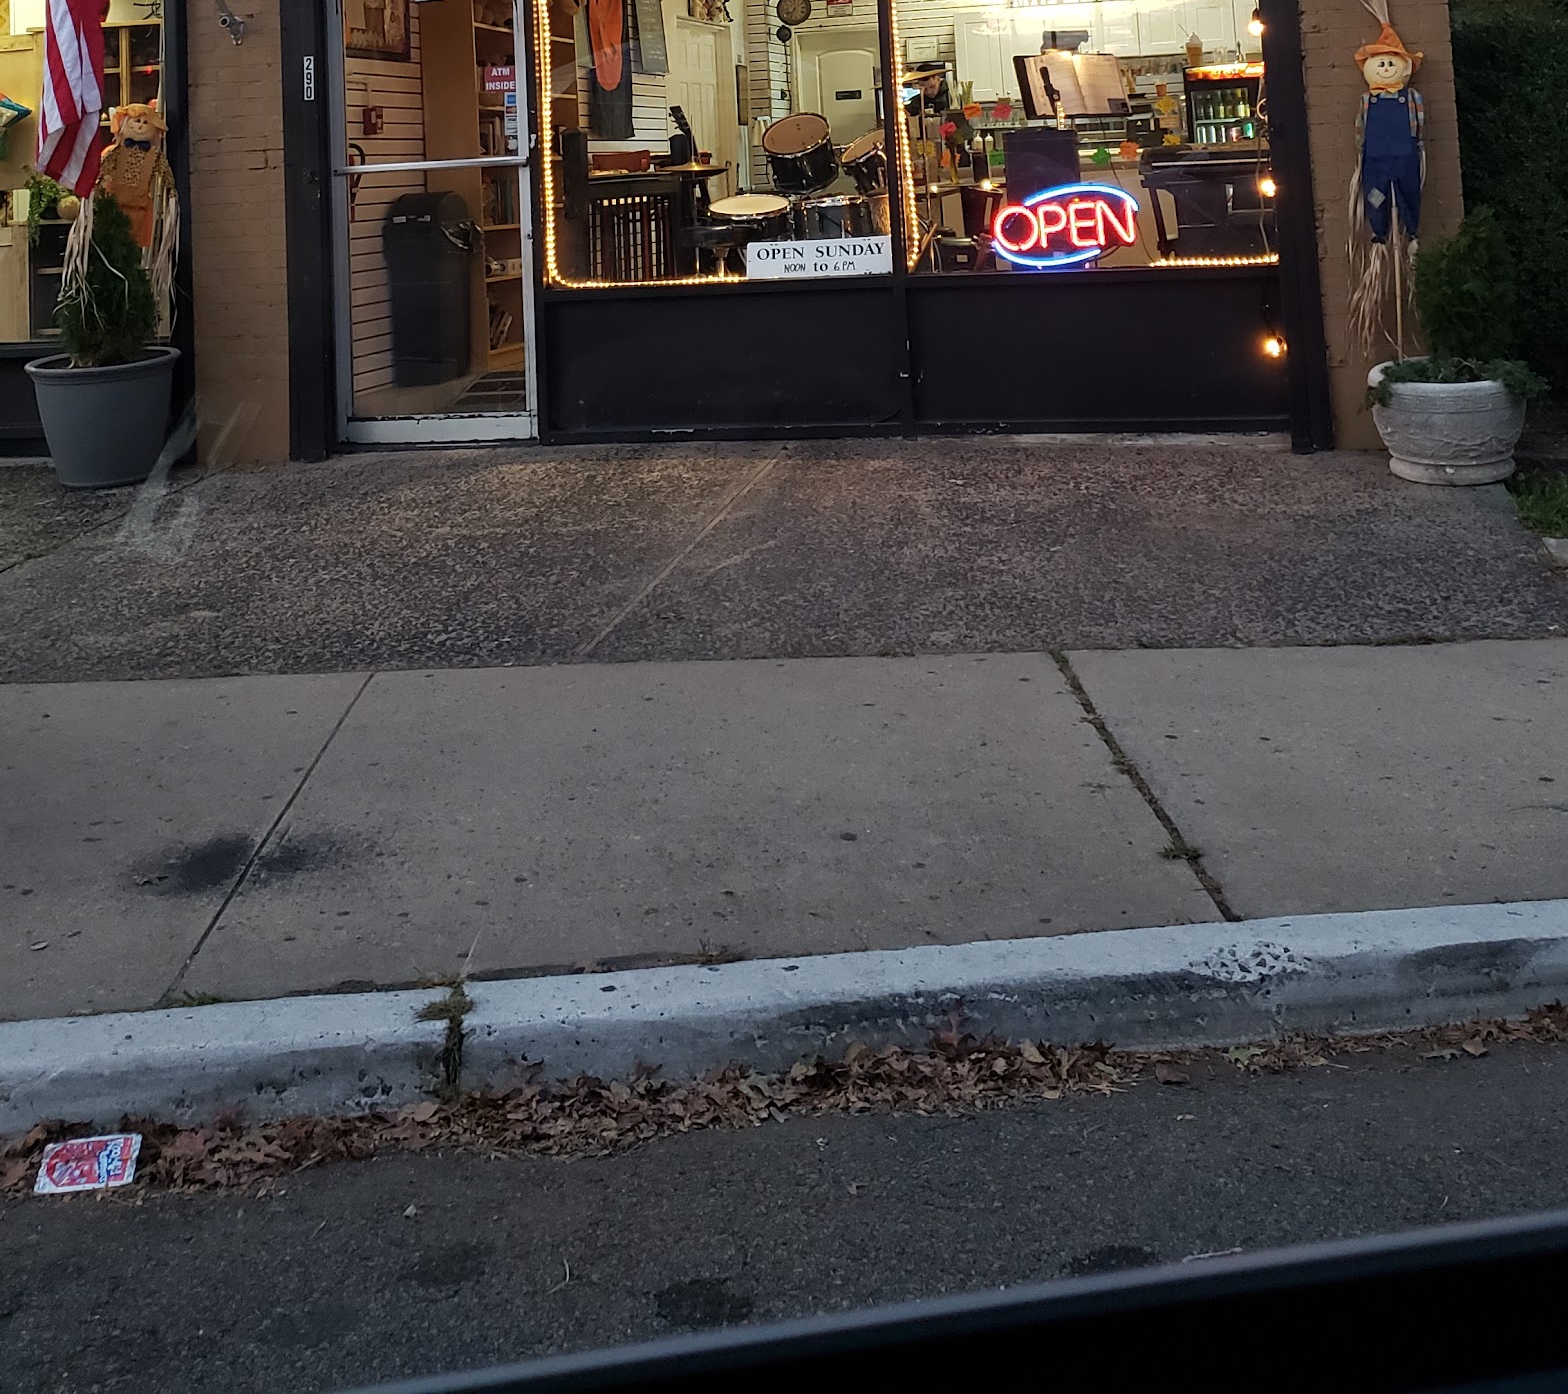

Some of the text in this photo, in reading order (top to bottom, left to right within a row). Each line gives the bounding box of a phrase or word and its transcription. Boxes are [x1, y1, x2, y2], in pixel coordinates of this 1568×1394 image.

[491, 68, 510, 77] ATM
[486, 81, 515, 90] INSIDE
[993, 199, 1136, 251] OPEN
[756, 242, 885, 260] OPEN SUNDAY
[784, 263, 806, 273] NOON
[813, 262, 828, 272] to
